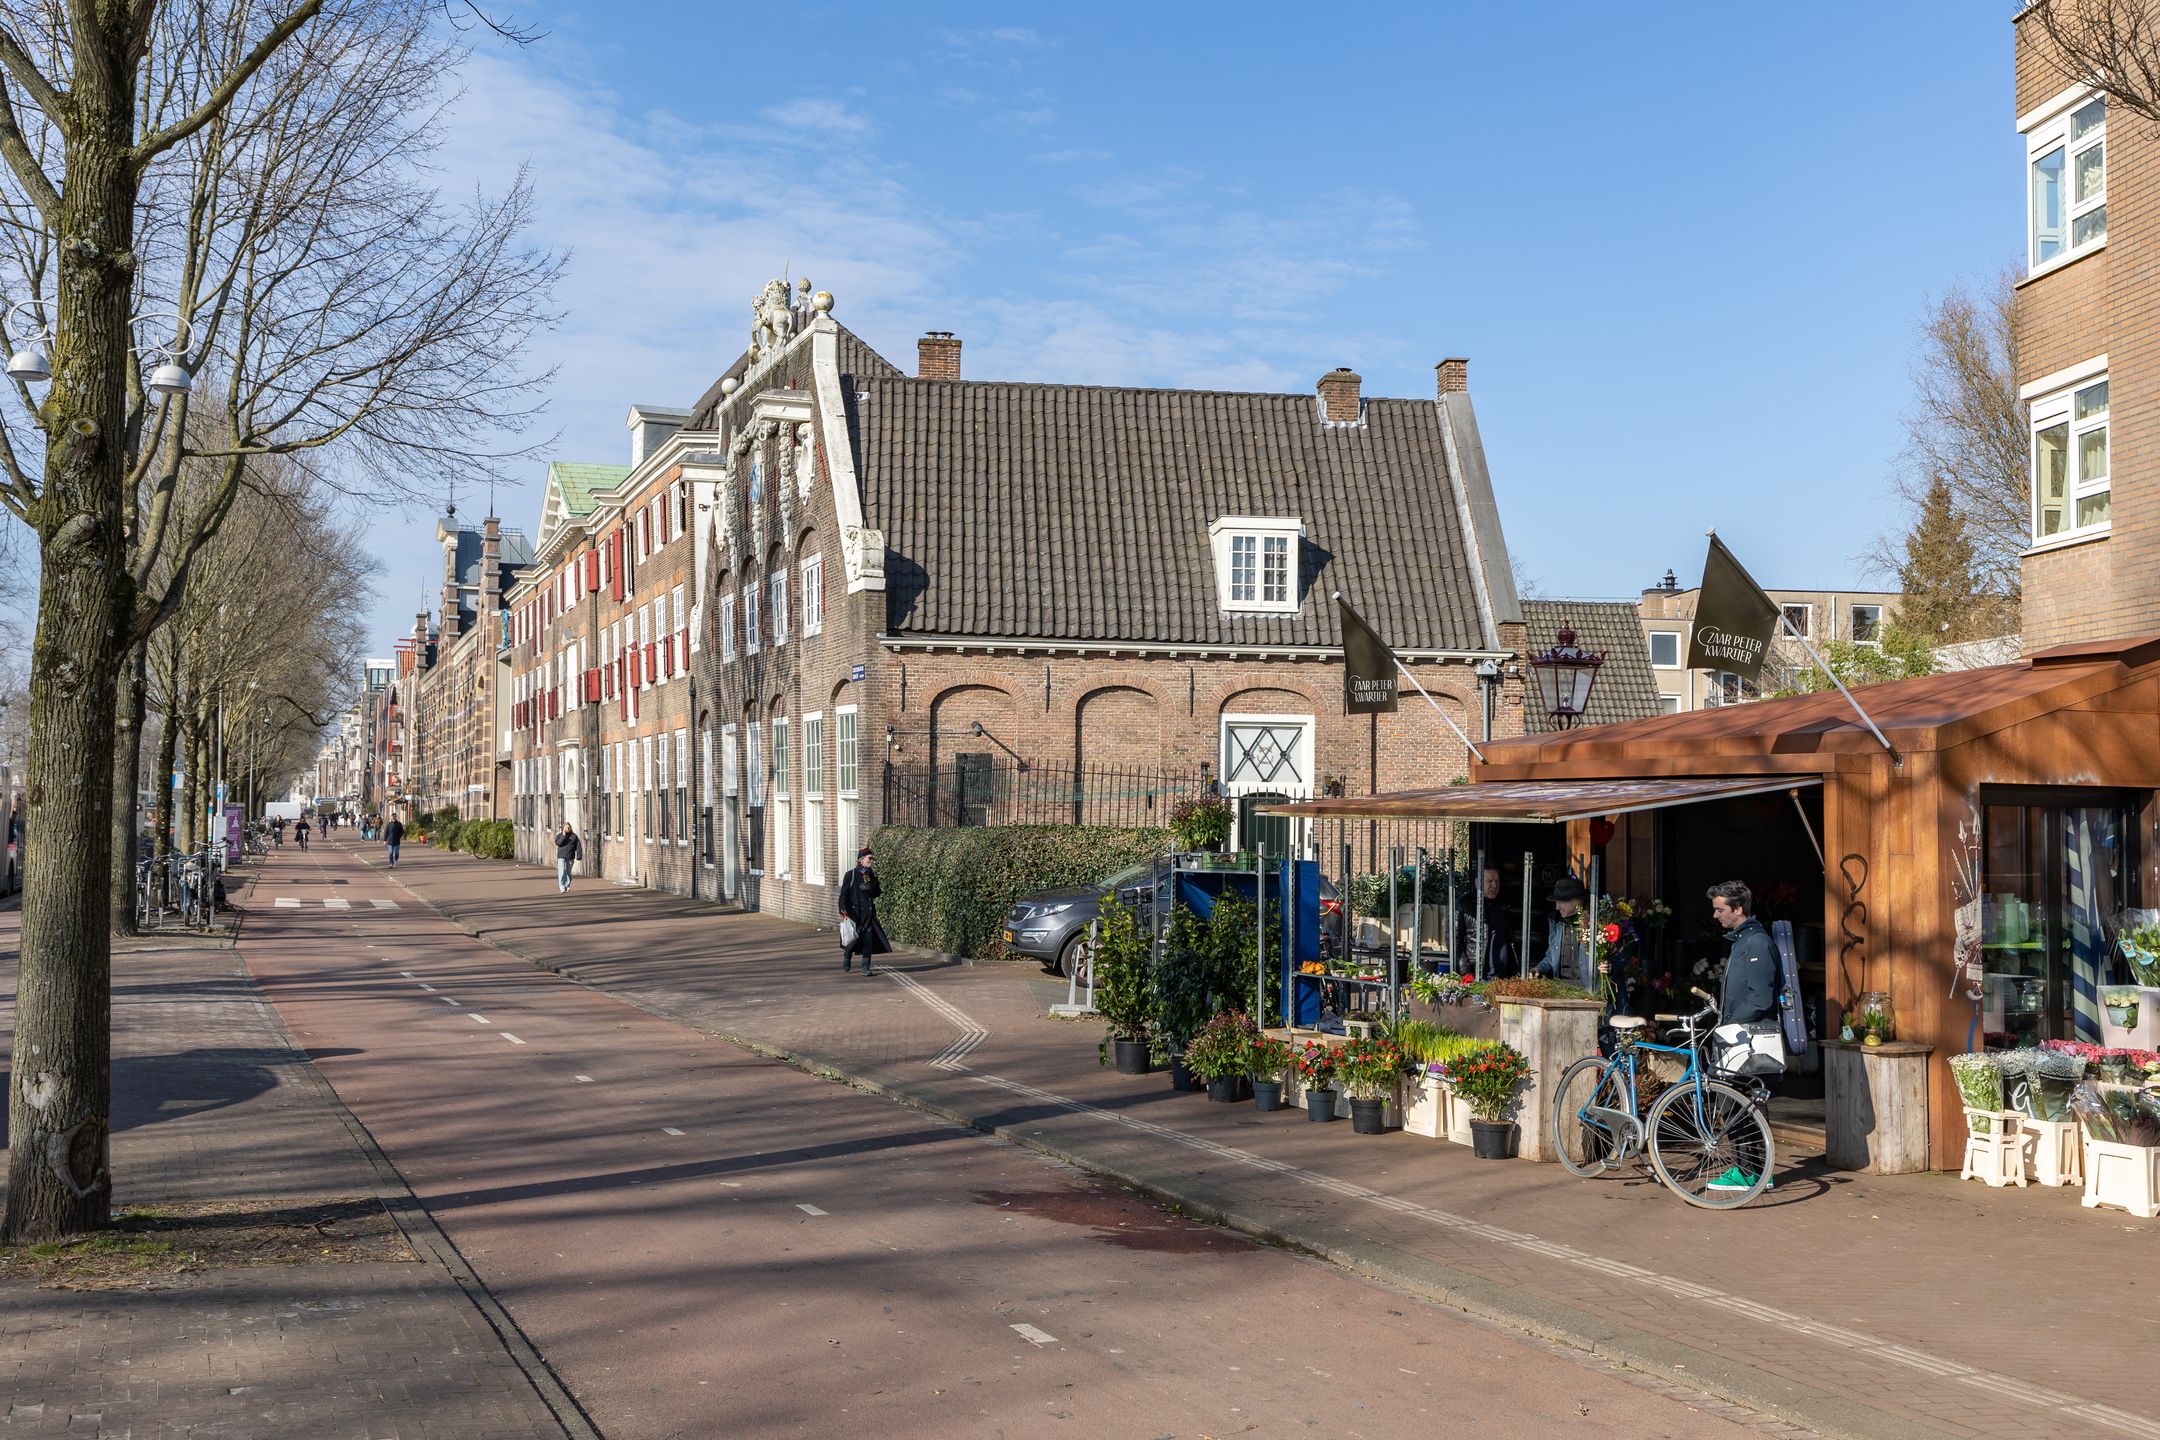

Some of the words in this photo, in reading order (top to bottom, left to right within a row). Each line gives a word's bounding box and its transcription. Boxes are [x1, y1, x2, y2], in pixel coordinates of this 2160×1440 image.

[1733, 635, 1762, 653] PETER
[1705, 645, 1752, 664] KWARTIER
[1371, 680, 1392, 690] PETER
[1354, 691, 1387, 702] KWARTIER
